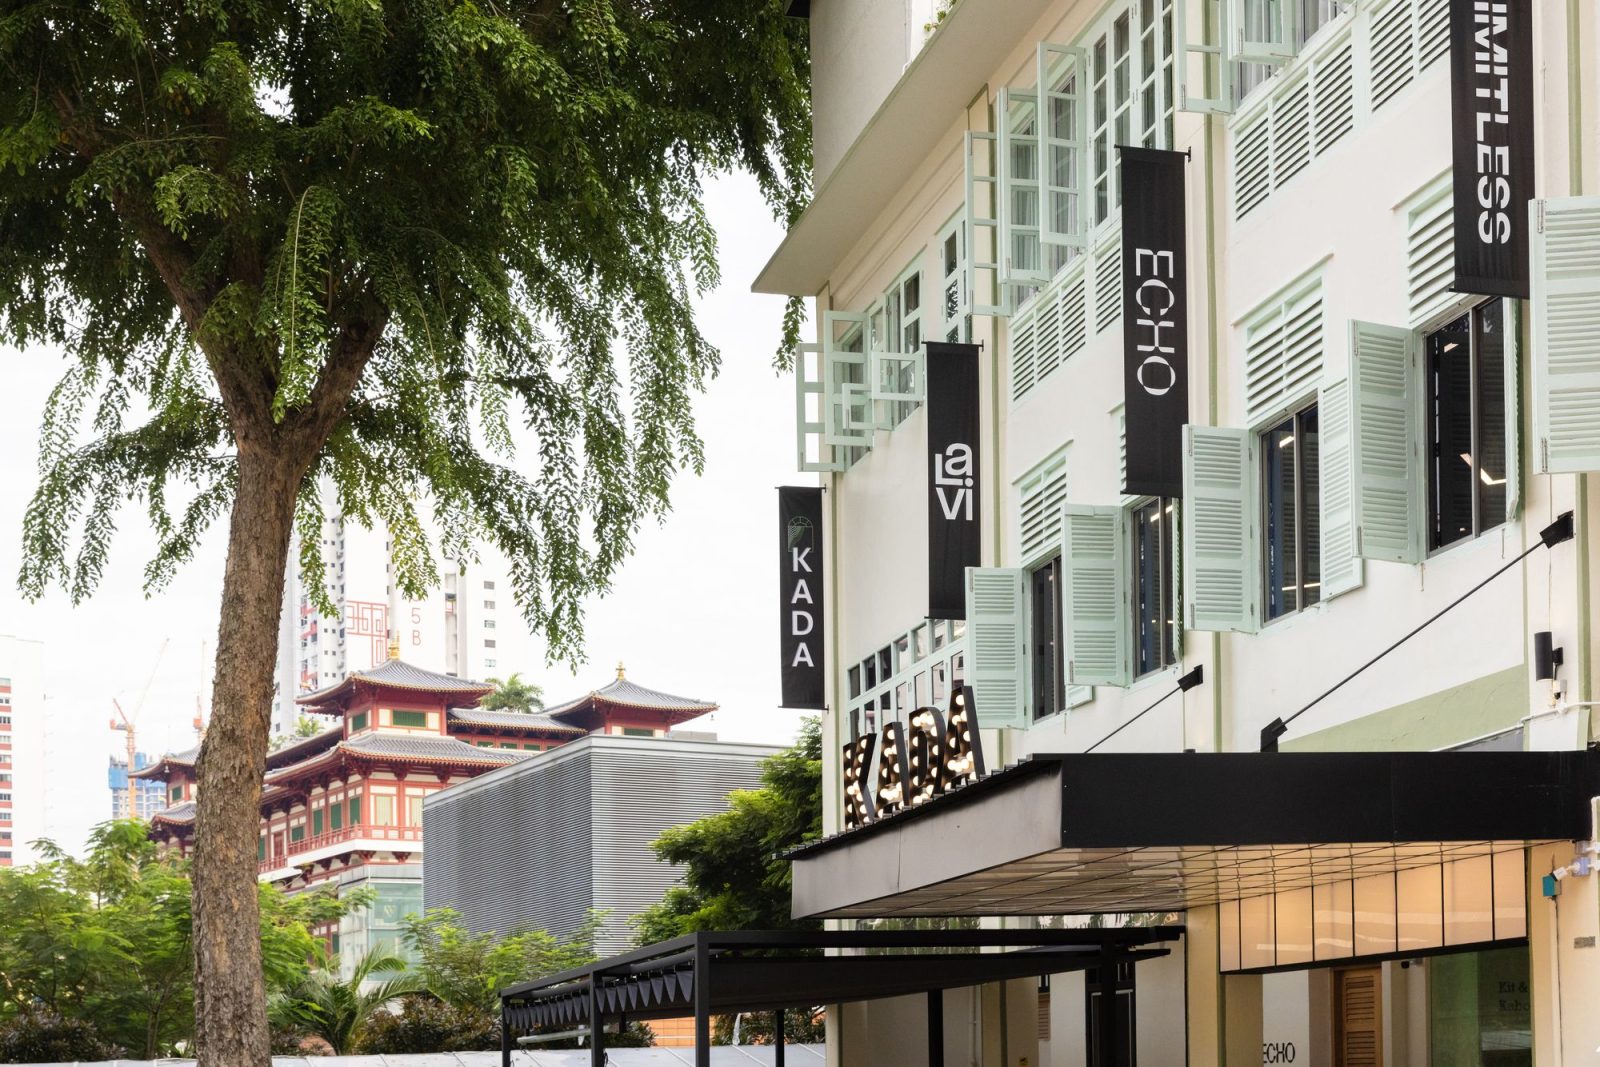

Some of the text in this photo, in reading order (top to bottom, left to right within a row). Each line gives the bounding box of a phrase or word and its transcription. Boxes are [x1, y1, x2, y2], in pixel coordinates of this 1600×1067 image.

[1136, 248, 1176, 395] ECHO
[411, 596, 422, 646] 5B
[791, 546, 815, 667] KADA
[843, 685, 986, 828] KADA
[1518, 981, 1528, 993] &
